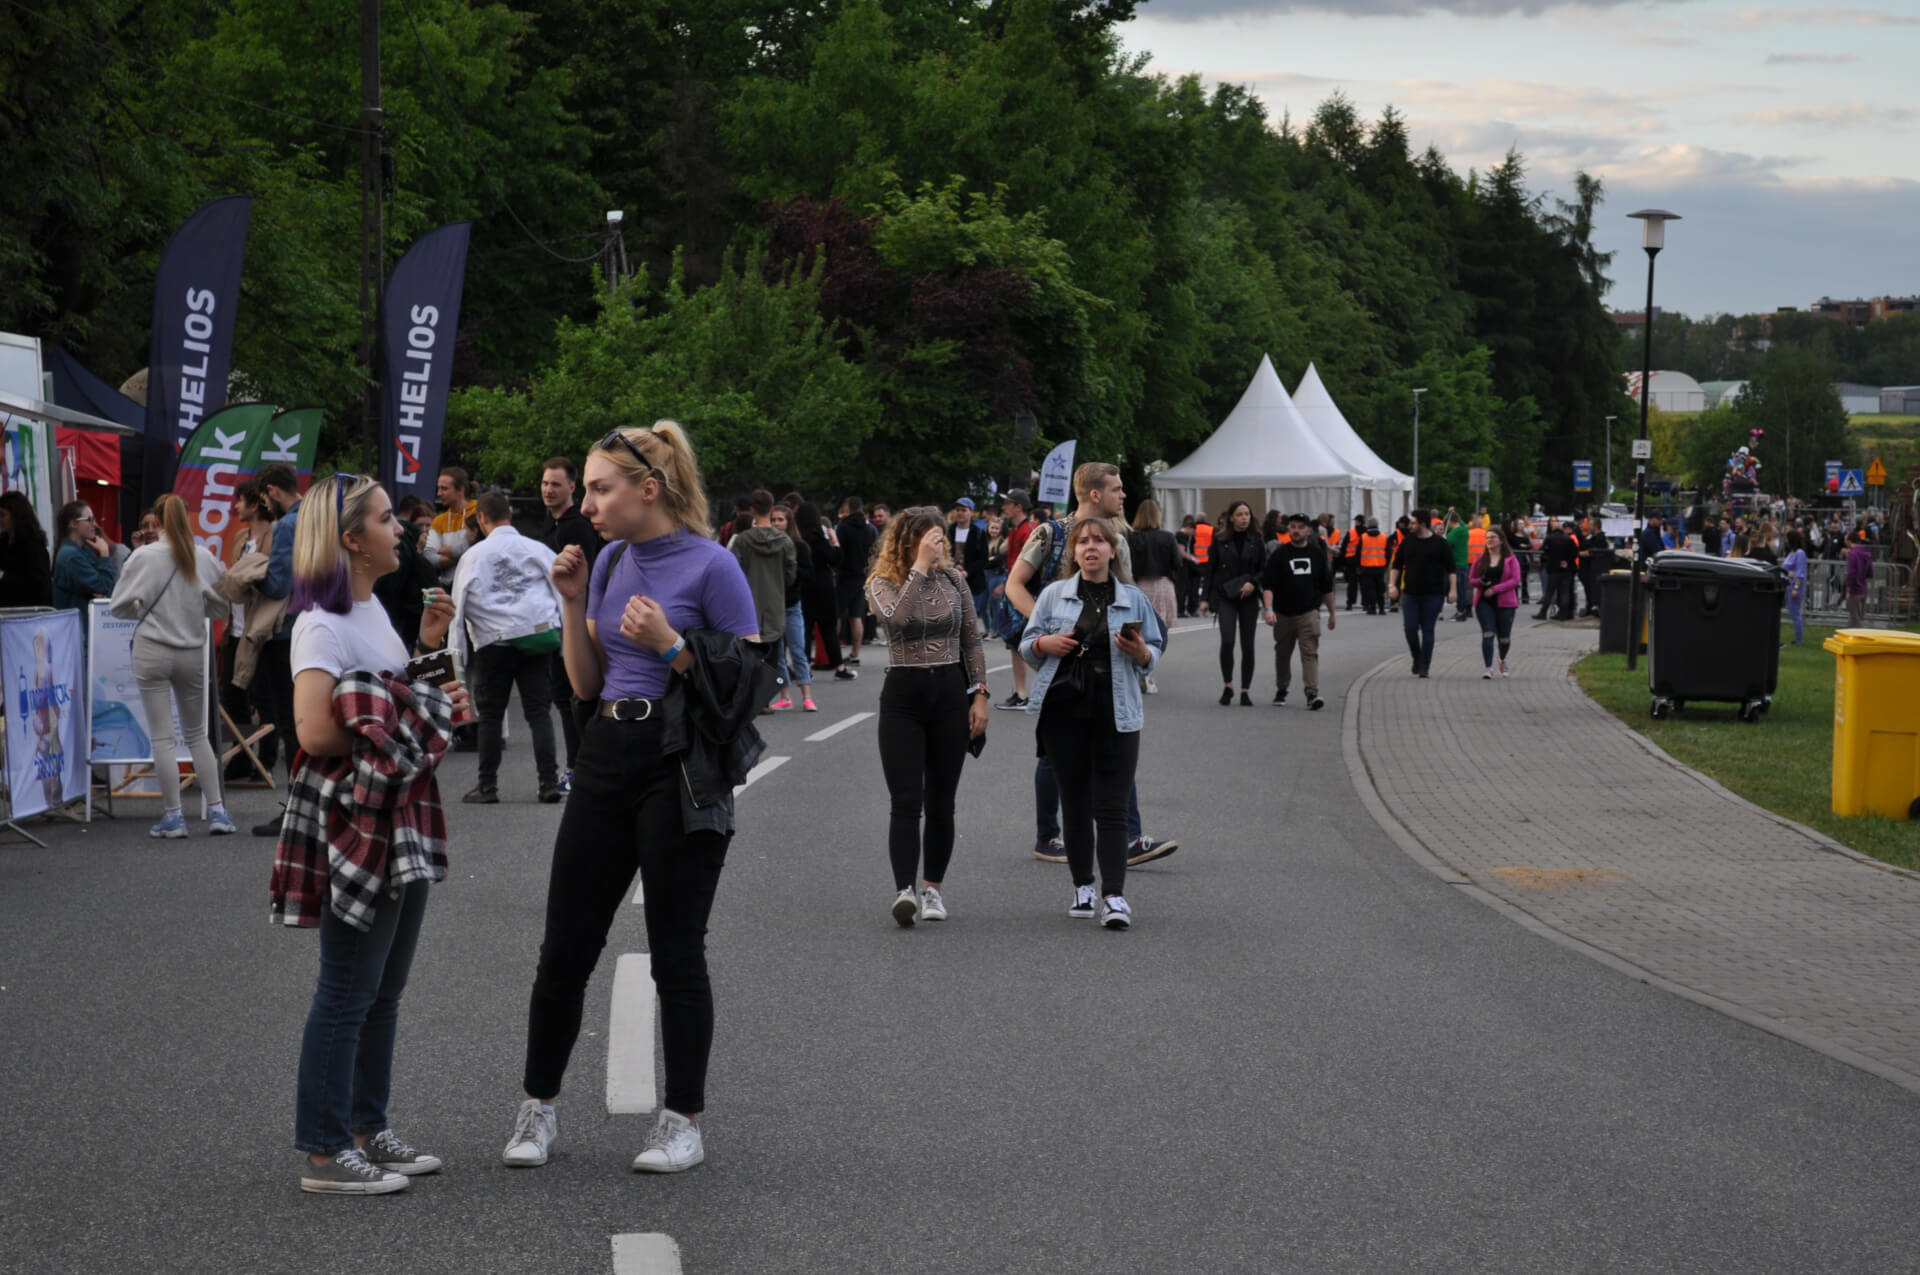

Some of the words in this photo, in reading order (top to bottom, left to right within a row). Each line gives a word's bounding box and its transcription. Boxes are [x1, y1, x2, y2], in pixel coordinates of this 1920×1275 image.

[178, 287, 216, 430] HELIOS
[399, 304, 439, 428] HELIOS
[193, 427, 247, 572] Bank
